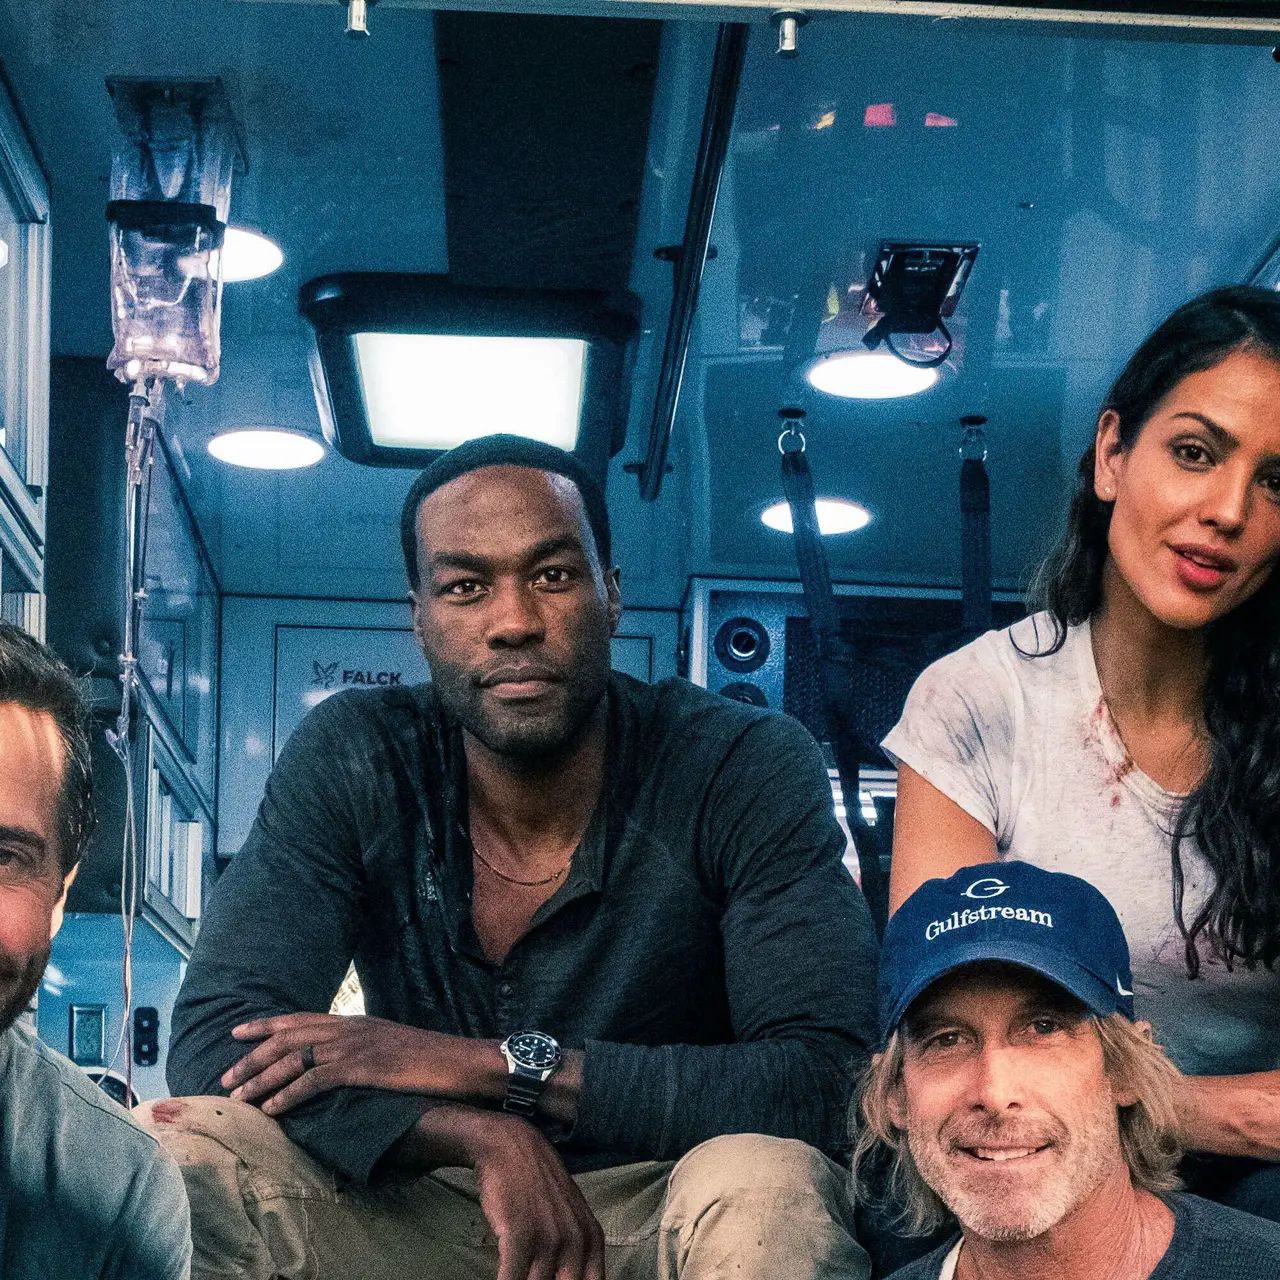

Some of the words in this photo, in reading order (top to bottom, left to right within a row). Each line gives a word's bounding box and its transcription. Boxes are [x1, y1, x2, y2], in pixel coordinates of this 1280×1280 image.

[342, 670, 402, 685] FALCK
[960, 878, 1010, 899] G
[925, 905, 1053, 940] Gulfstream
